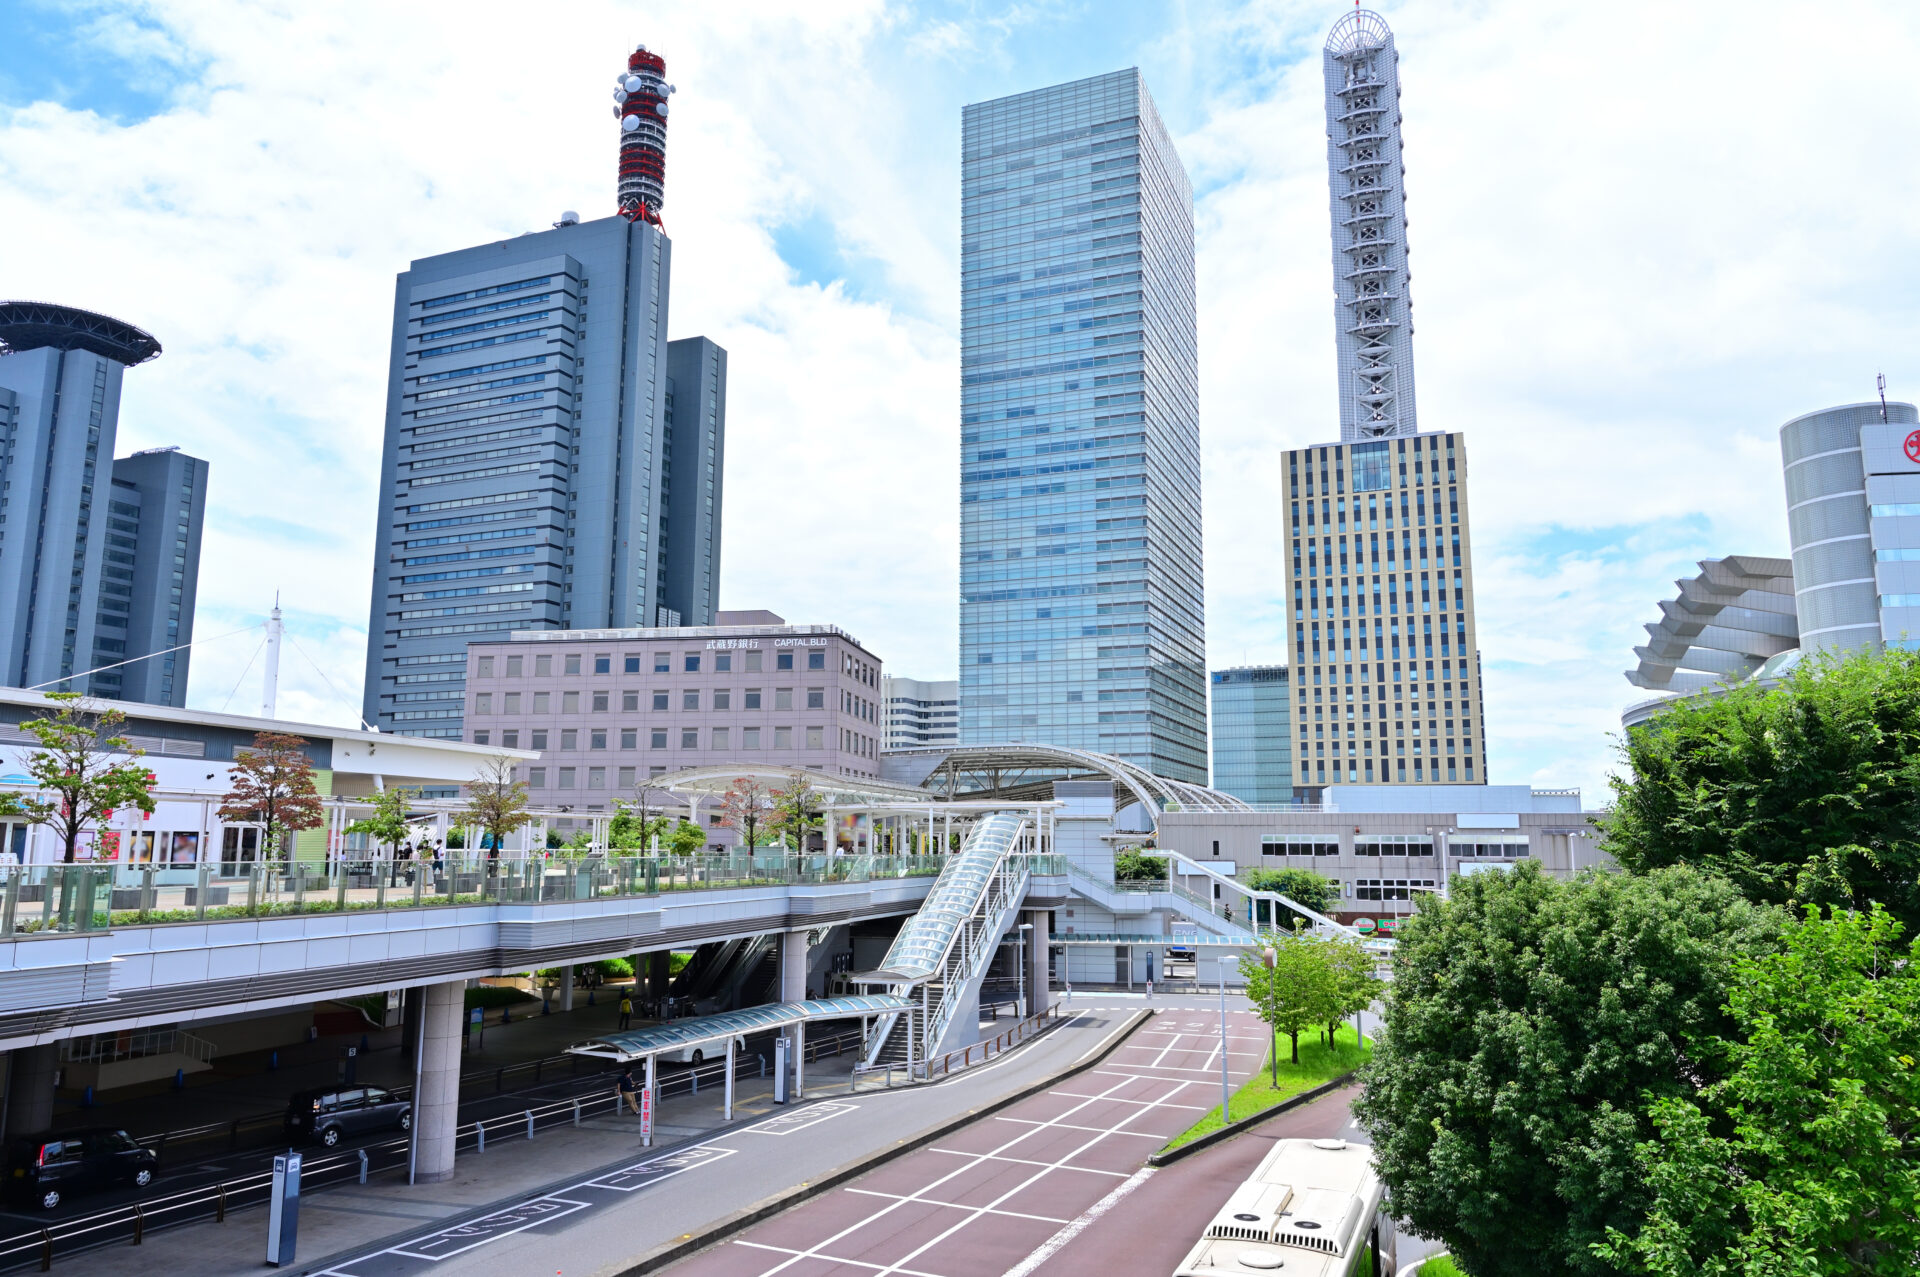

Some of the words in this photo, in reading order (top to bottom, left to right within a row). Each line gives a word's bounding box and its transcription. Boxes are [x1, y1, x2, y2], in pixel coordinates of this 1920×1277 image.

[705, 639, 760, 650] 武蔵野銀行
[774, 638, 808, 647] CAPITAL
